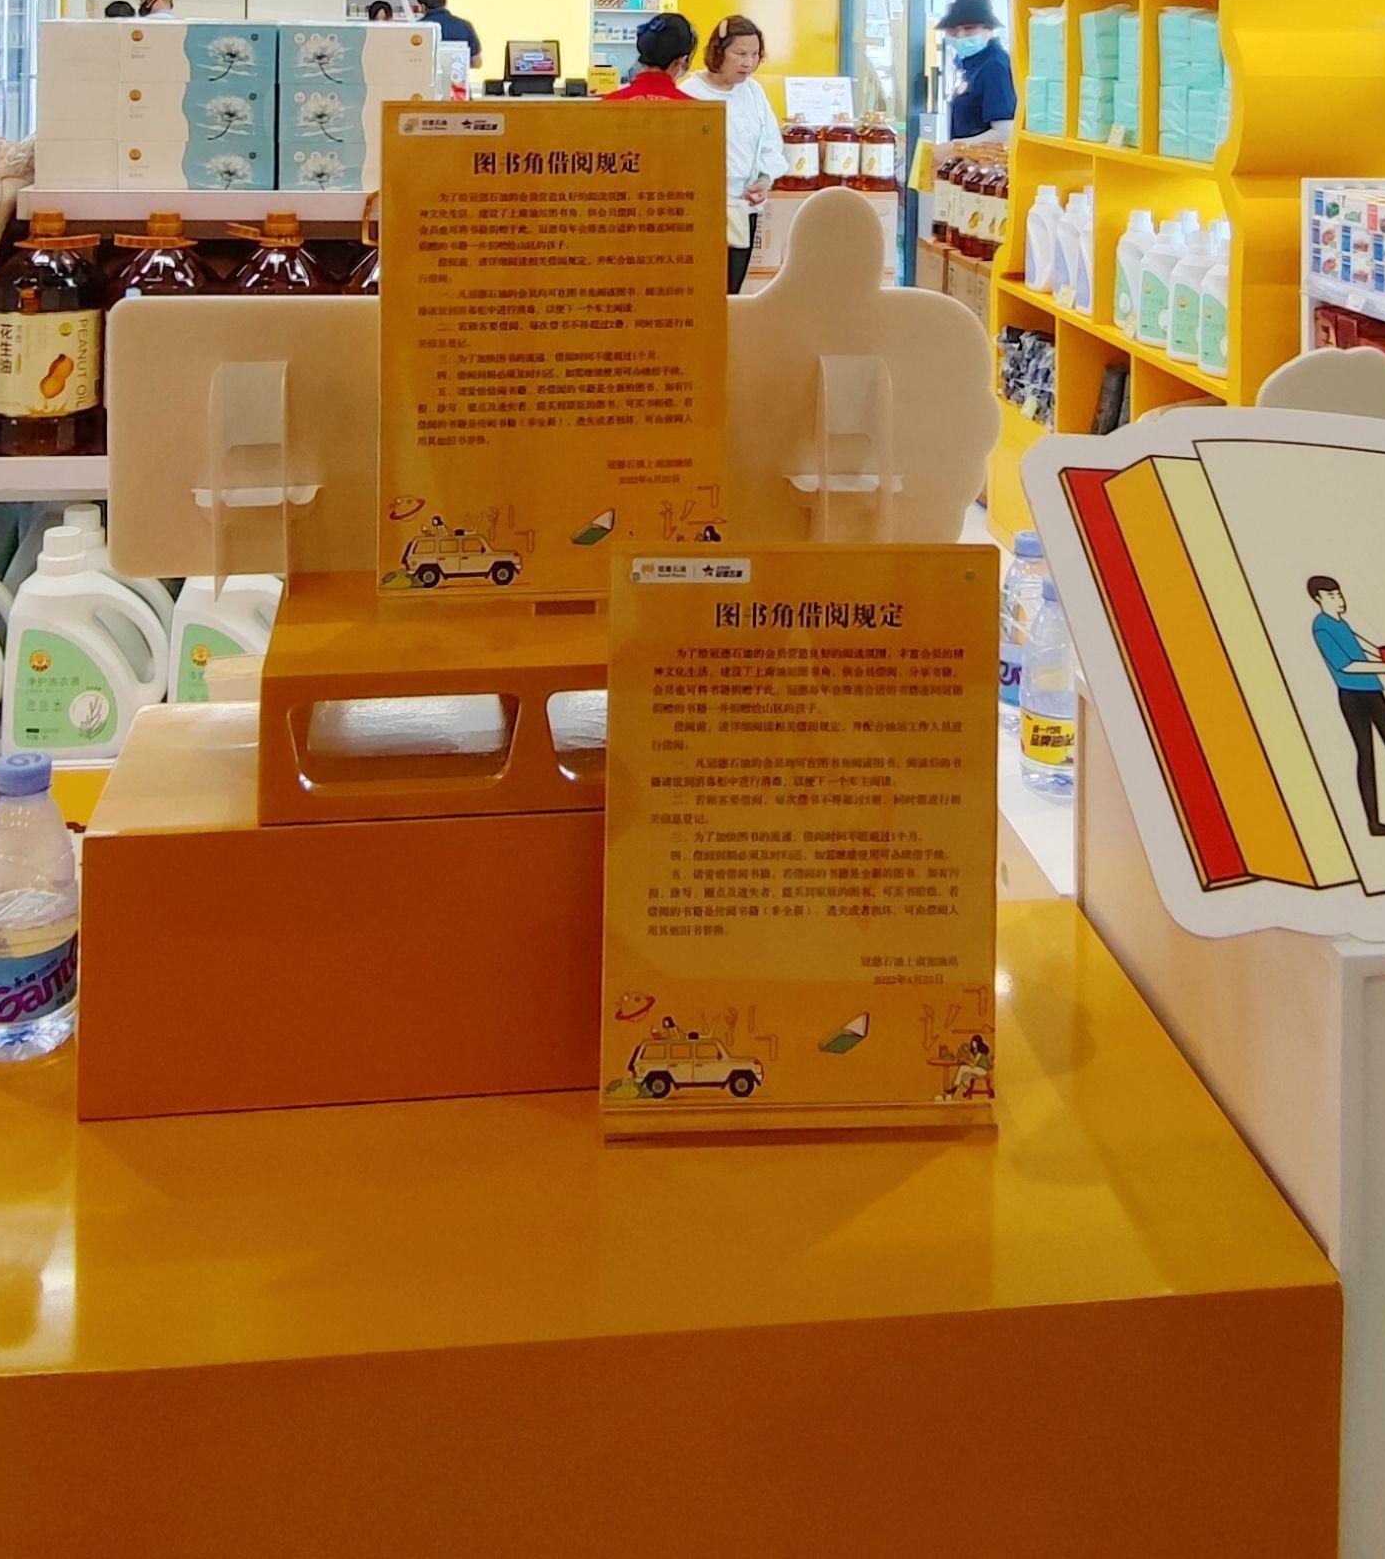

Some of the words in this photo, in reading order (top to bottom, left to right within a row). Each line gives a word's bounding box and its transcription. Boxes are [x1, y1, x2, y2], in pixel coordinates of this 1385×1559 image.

[473, 151, 641, 175] 图书角借阅规定
[77, 319, 88, 377] PEANUT
[76, 385, 87, 408] OIL
[715, 601, 903, 629] 图书角借阅规定
